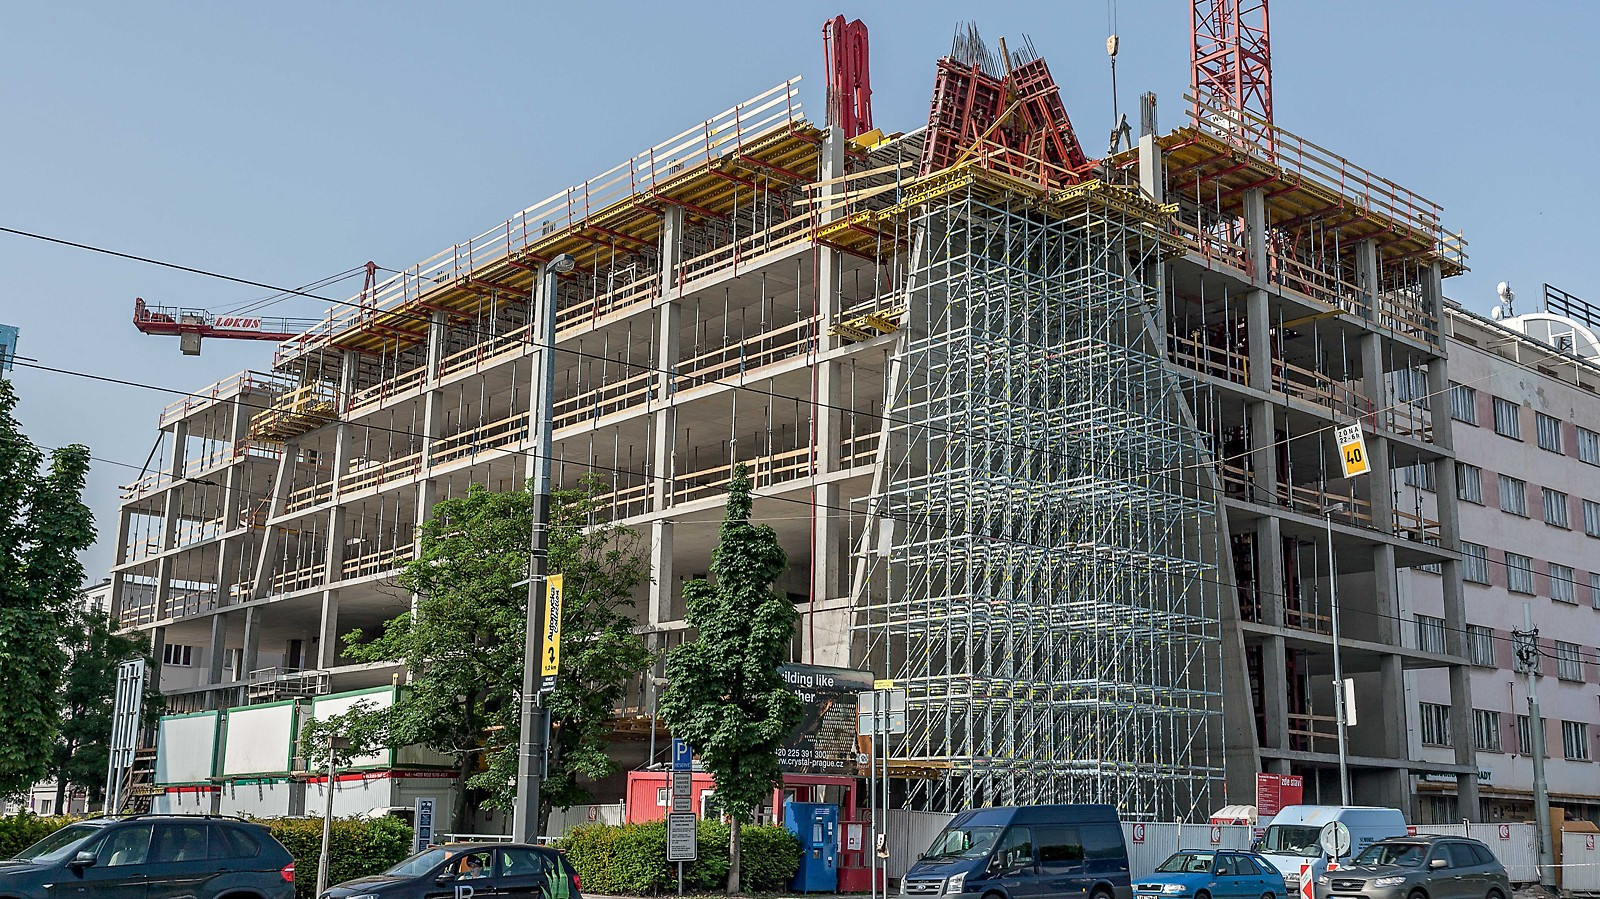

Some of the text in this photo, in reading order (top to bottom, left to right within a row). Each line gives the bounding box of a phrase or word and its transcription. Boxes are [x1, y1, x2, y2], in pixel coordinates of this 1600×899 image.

[215, 317, 261, 328] LOKUS
[1338, 427, 1358, 437] ZONA
[1346, 448, 1362, 464] 40
[816, 674, 834, 686] like
[787, 749, 800, 757] 225
[801, 750, 813, 758] 391
[814, 750, 827, 759] 300
